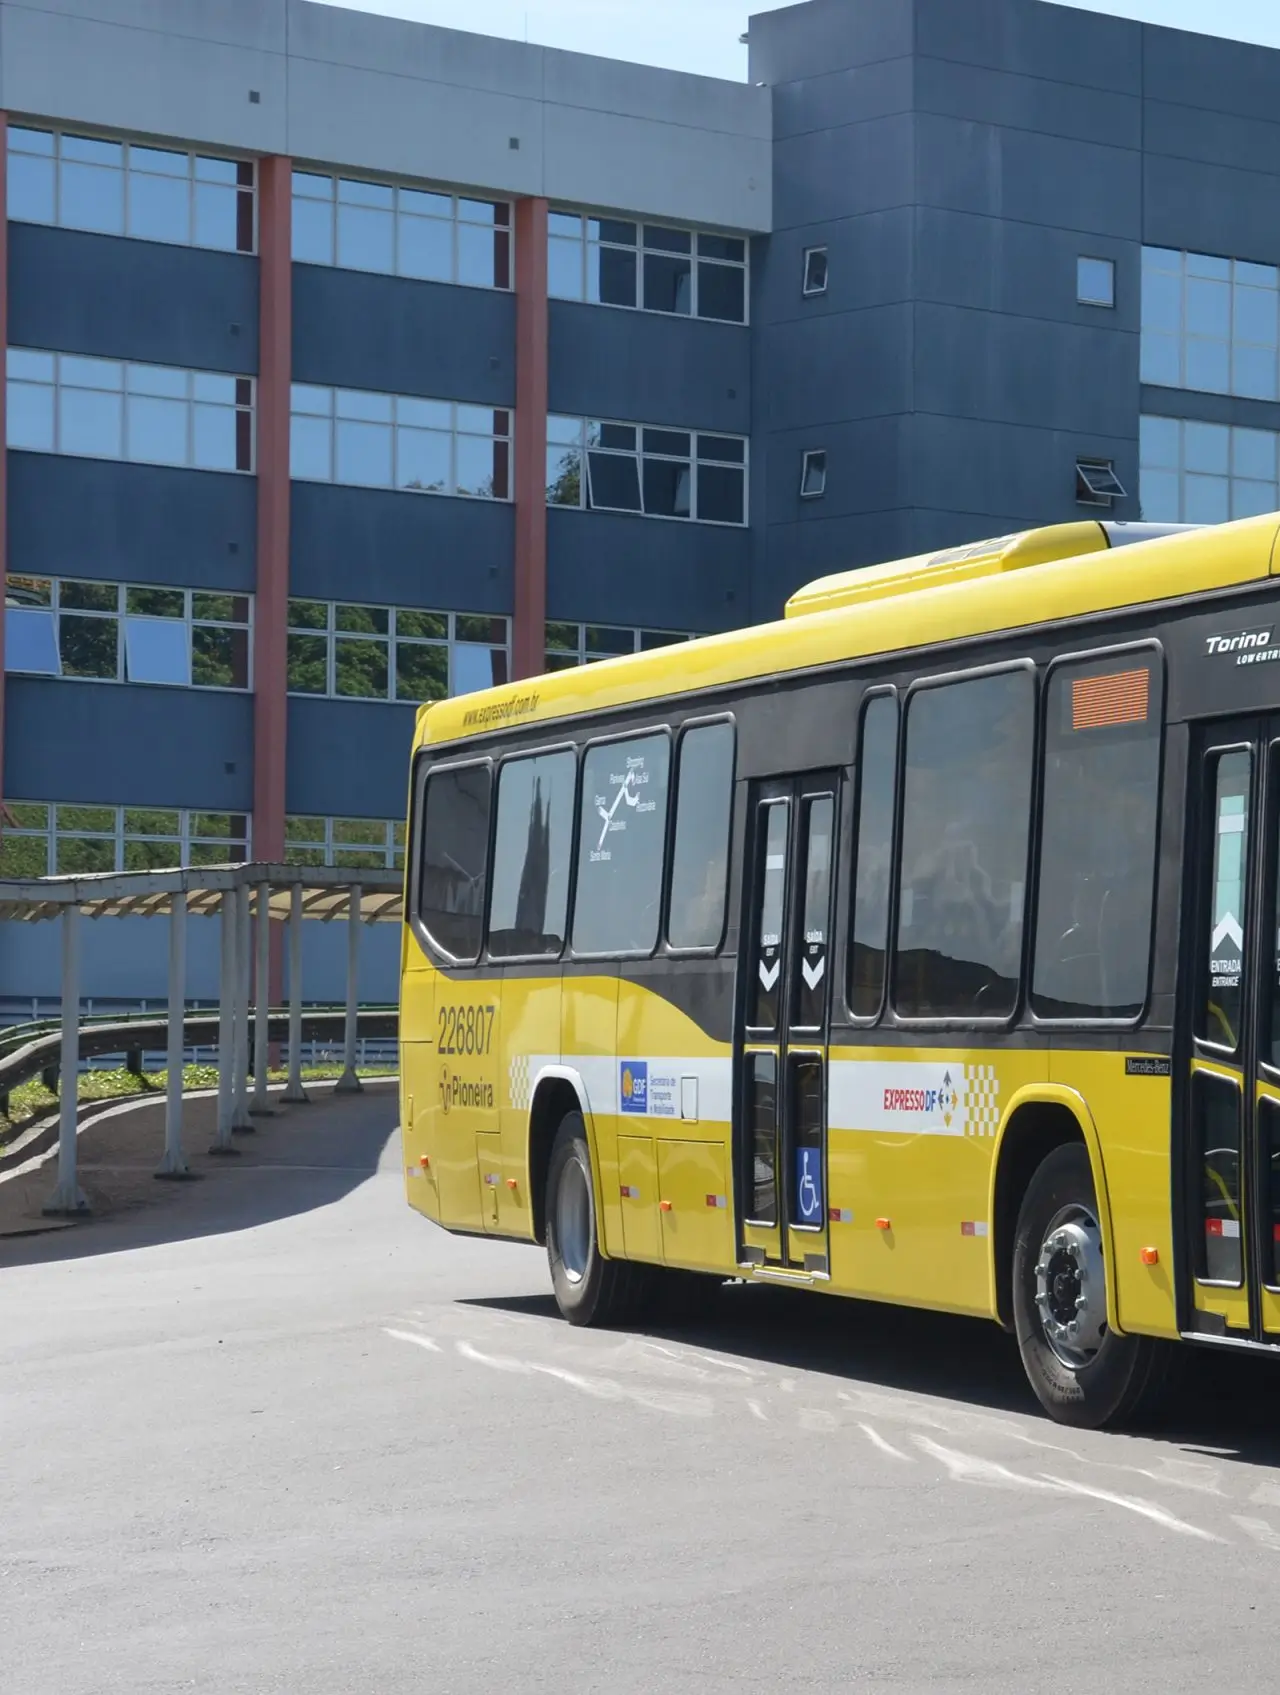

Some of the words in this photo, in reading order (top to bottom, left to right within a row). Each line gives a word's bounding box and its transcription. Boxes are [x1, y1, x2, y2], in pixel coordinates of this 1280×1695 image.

[1206, 631, 1271, 655] Torino
[1236, 653, 1256, 666] LOW
[1210, 959, 1242, 973] ENTRADA
[1212, 976, 1240, 987] ENTRANCE
[437, 1004, 496, 1056] 226807
[452, 1075, 493, 1107] Pioneira
